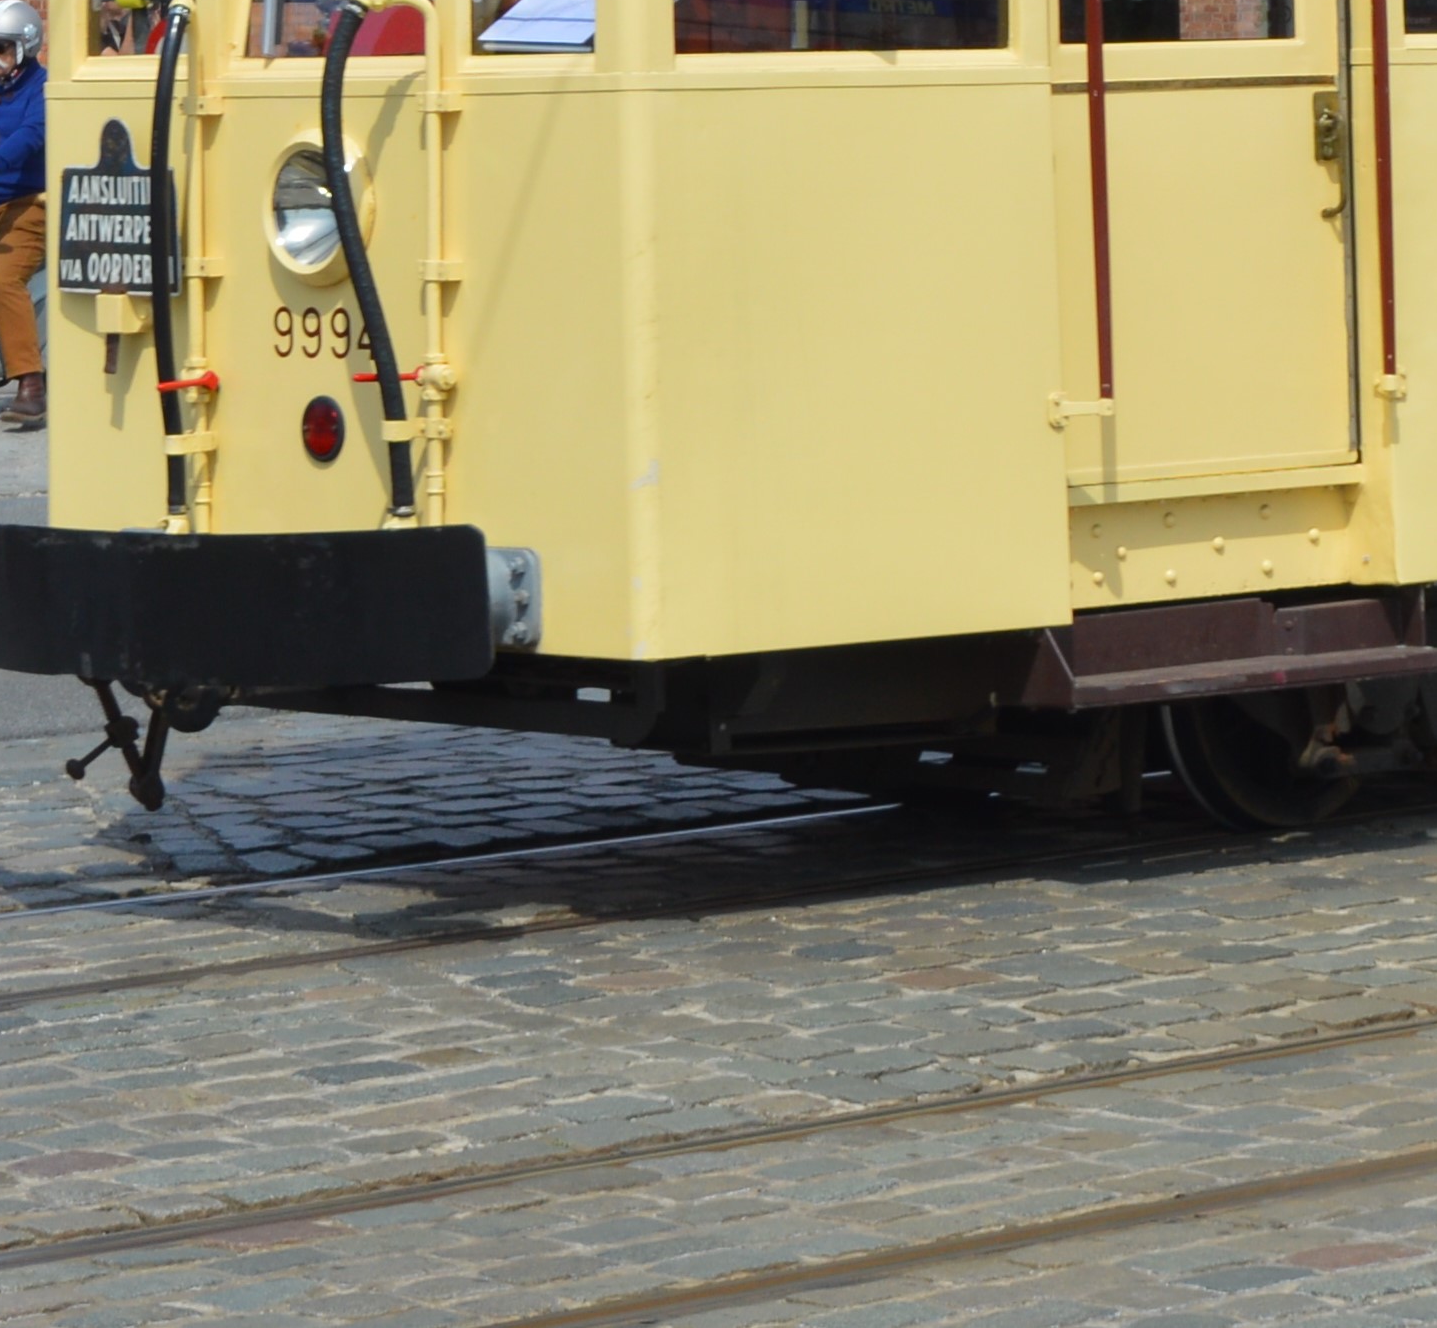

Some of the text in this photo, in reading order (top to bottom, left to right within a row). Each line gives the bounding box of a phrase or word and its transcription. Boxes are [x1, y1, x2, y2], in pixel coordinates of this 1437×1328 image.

[68, 175, 151, 205] AANSLUITI
[65, 213, 152, 245] ANTWERPE
[60, 258, 83, 282] VIA
